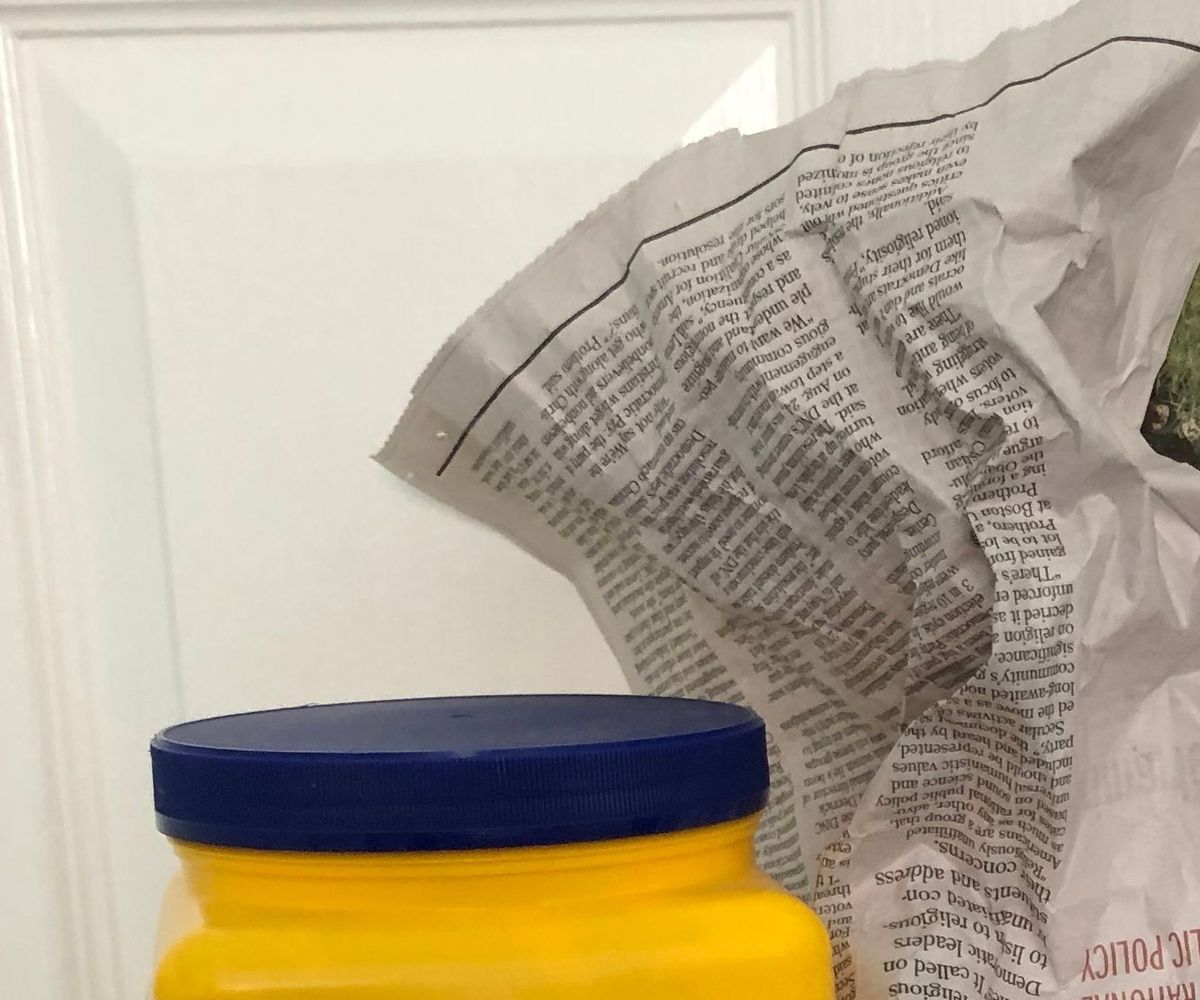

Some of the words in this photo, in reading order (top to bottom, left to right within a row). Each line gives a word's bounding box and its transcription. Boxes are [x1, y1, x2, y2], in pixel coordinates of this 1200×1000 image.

[882, 254, 911, 277] their
[876, 258, 940, 296] Democrats
[980, 501, 1032, 518] Boston
[1037, 499, 1051, 511] at
[987, 518, 1056, 534] Prothero,
[1013, 583, 1073, 603] unforced
[1010, 611, 1020, 624] it
[1024, 603, 1072, 624] decried
[1004, 626, 1054, 643] religion
[1058, 623, 1073, 637] on
[993, 642, 1073, 663] significance.
[991, 681, 1074, 703] long-awaited
[1018, 720, 1064, 739] Secular
[891, 761, 937, 773] values
[942, 759, 1011, 789] humanistic
[891, 779, 917, 792] and
[922, 773, 973, 786] science
[875, 791, 917, 807] policy
[922, 785, 964, 799] public
[934, 840, 1016, 874] concerns.
[874, 864, 944, 885] address
[950, 869, 979, 891] and
[901, 889, 940, 902] con-
[882, 907, 967, 930] religious-
[972, 921, 989, 939] to
[893, 934, 961, 957] leaders
[883, 958, 907, 974] on
[1081, 934, 1163, 982] POLICY
[914, 958, 969, 979] called
